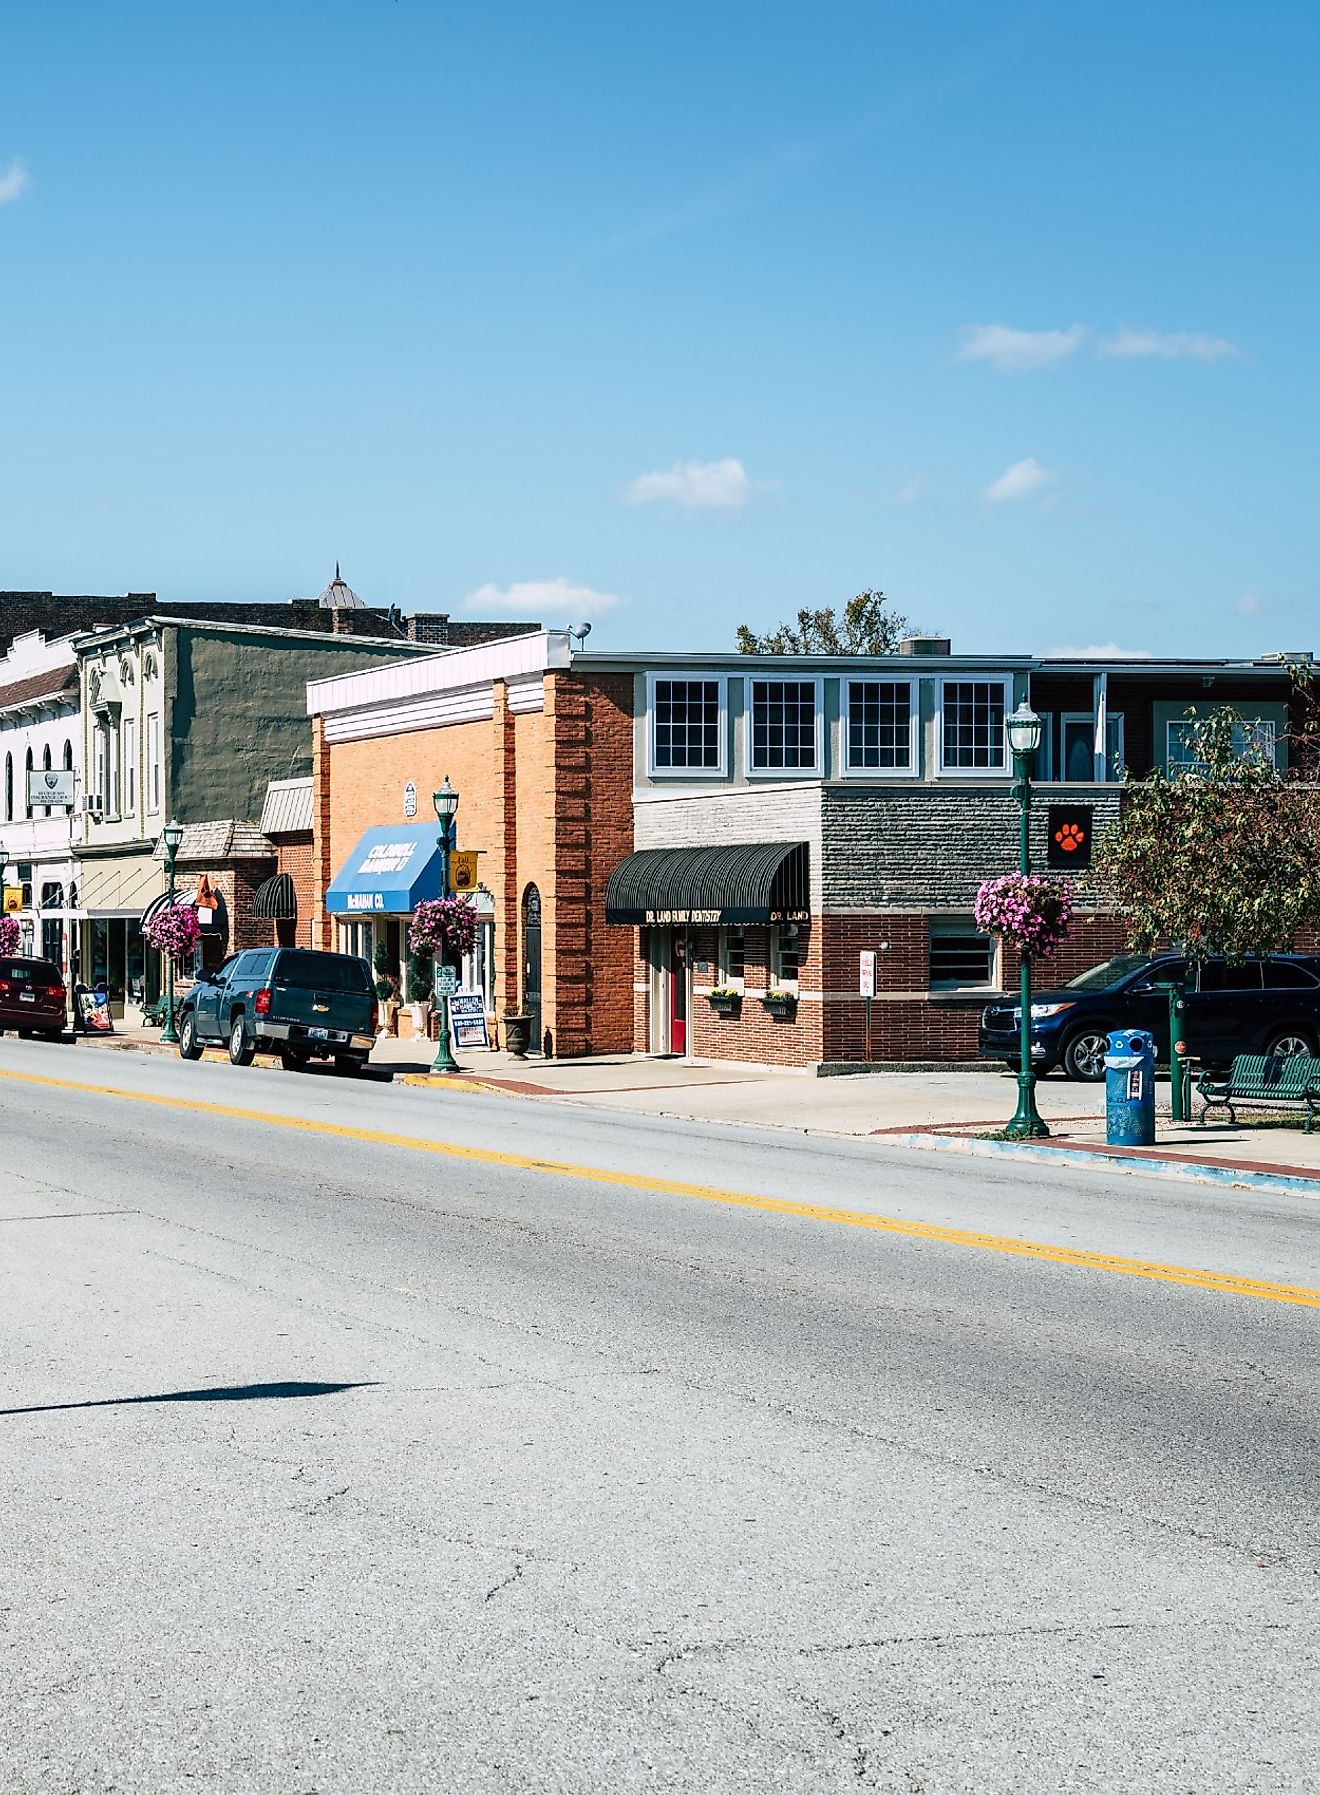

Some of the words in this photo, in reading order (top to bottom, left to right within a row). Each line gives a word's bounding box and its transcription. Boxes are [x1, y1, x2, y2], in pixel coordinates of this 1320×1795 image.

[646, 910, 656, 923] DR.
[656, 910, 671, 923] LAND
[671, 910, 690, 923] FAMILY
[691, 910, 722, 923] DENTISTRY
[786, 910, 809, 921] LAND
